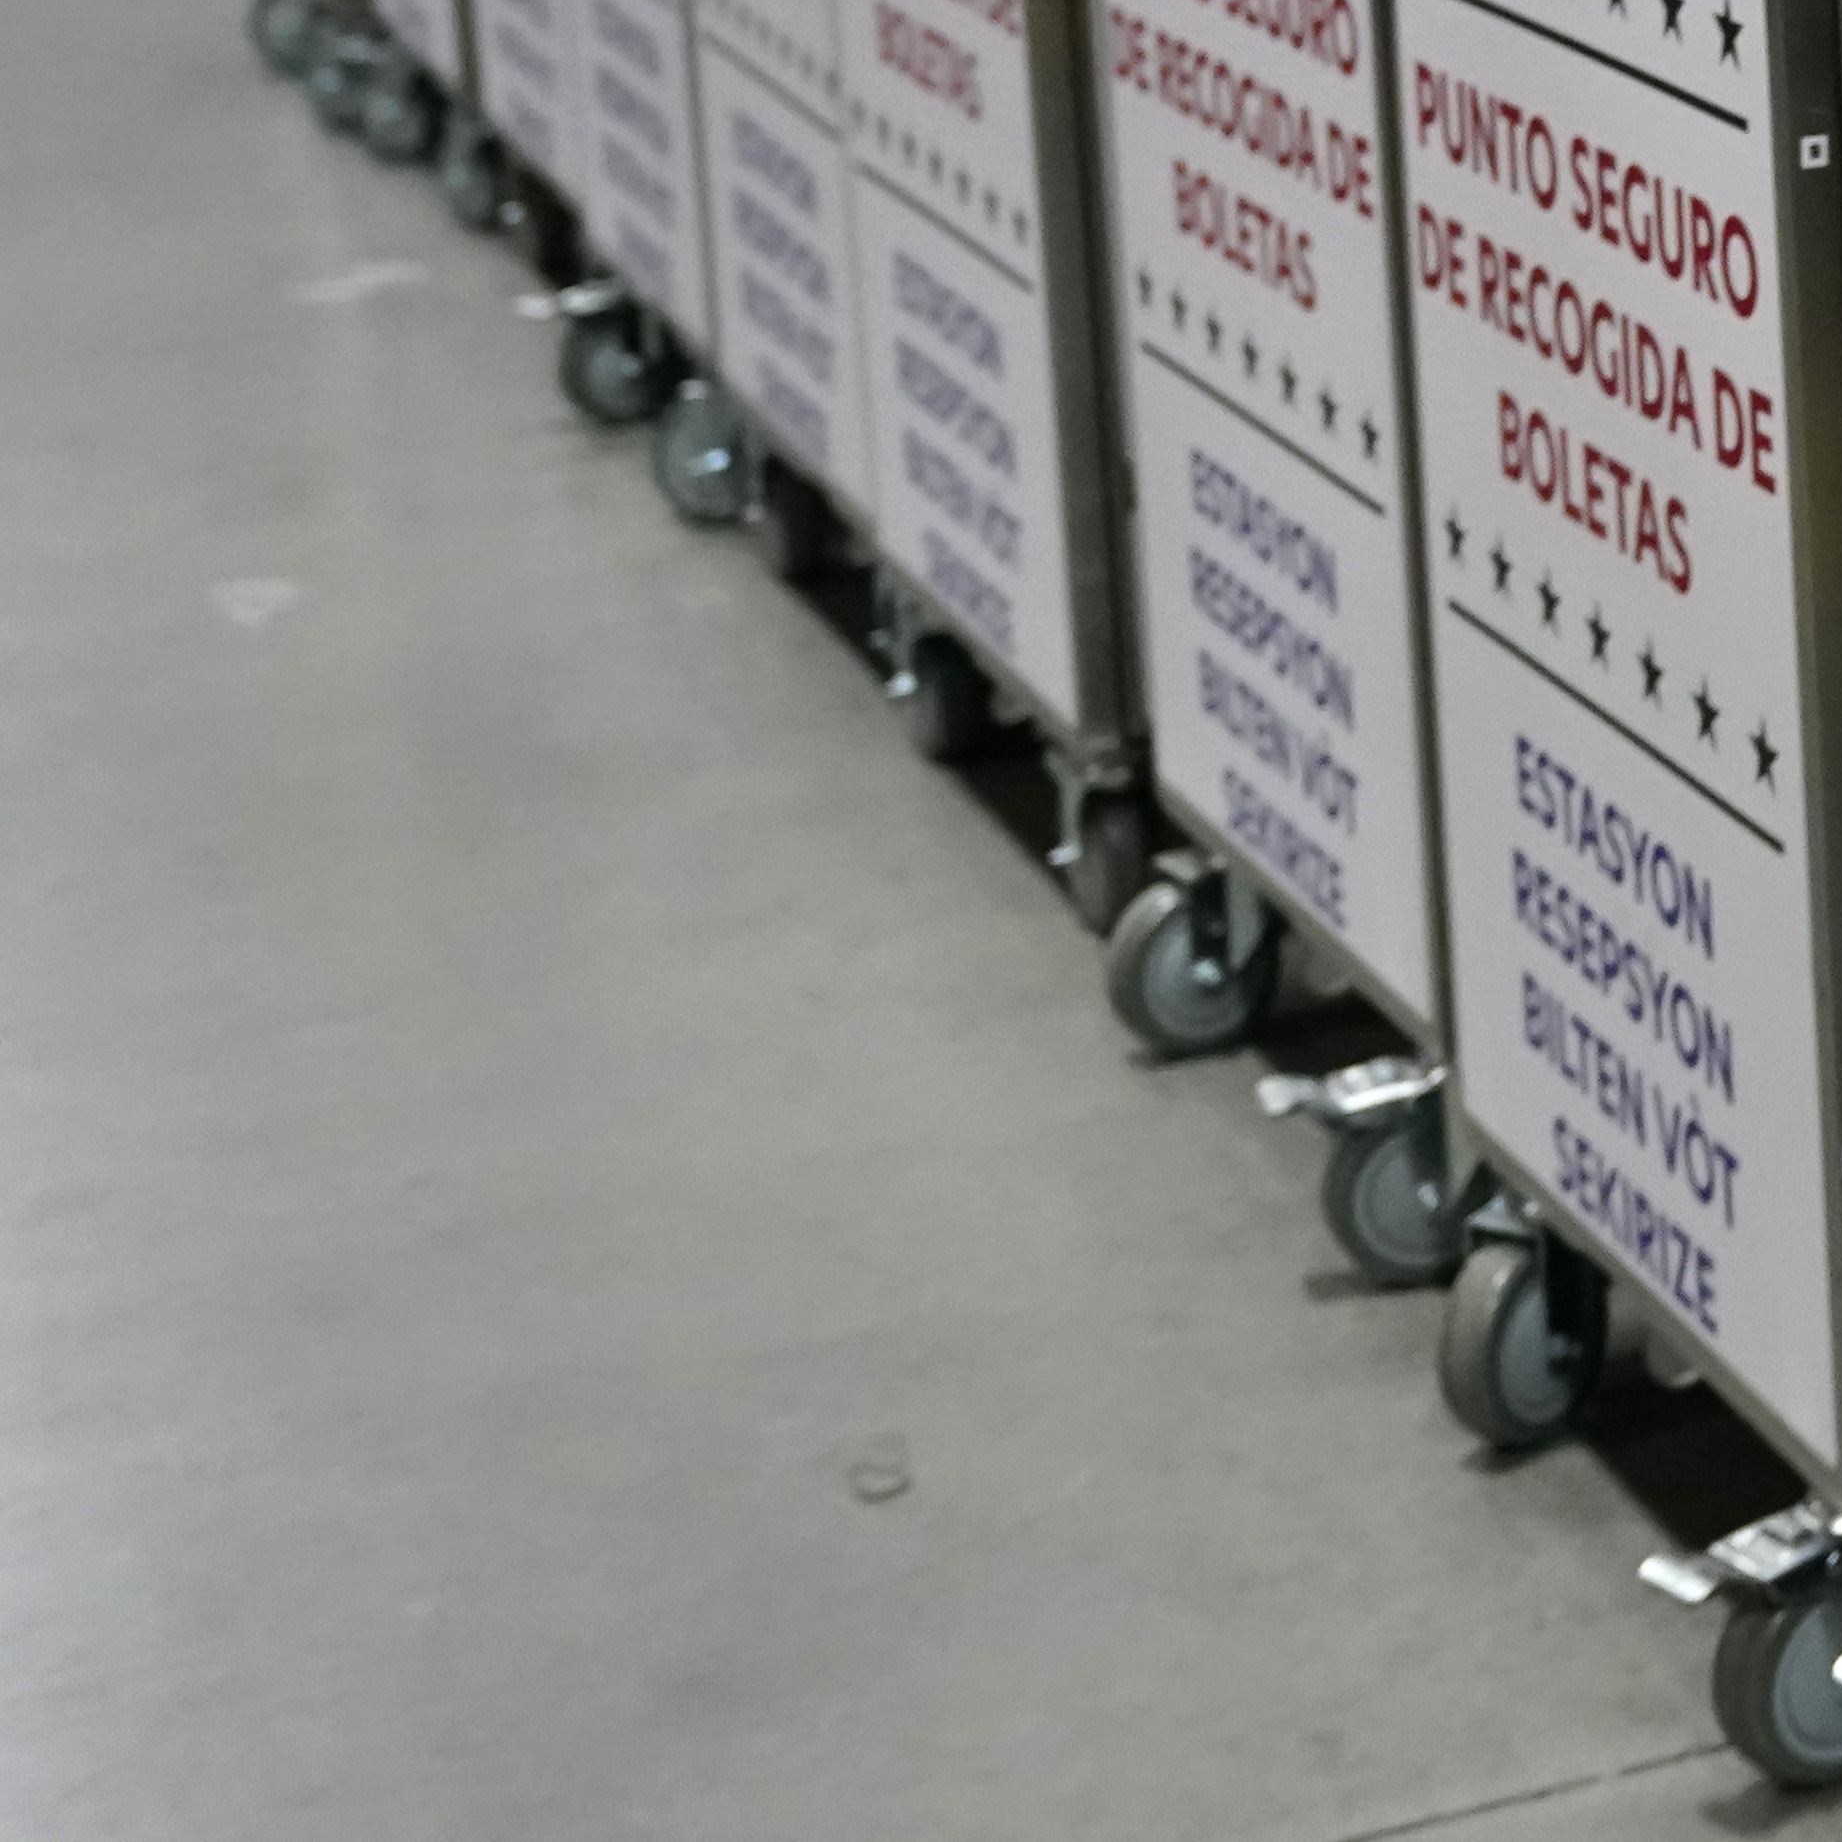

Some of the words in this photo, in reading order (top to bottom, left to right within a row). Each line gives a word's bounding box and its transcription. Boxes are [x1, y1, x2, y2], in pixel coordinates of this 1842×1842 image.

[1416, 61, 1557, 210] PUNTO
[1572, 138, 1758, 319] SEGURO
[1417, 203, 1468, 309] DE
[1479, 236, 1701, 451] RECOGIDA
[1714, 366, 1776, 494] DE
[1499, 389, 1693, 595] BOLETAS
[1517, 735, 1714, 960] ESTASYON
[1523, 972, 1646, 1147] BILTEN
